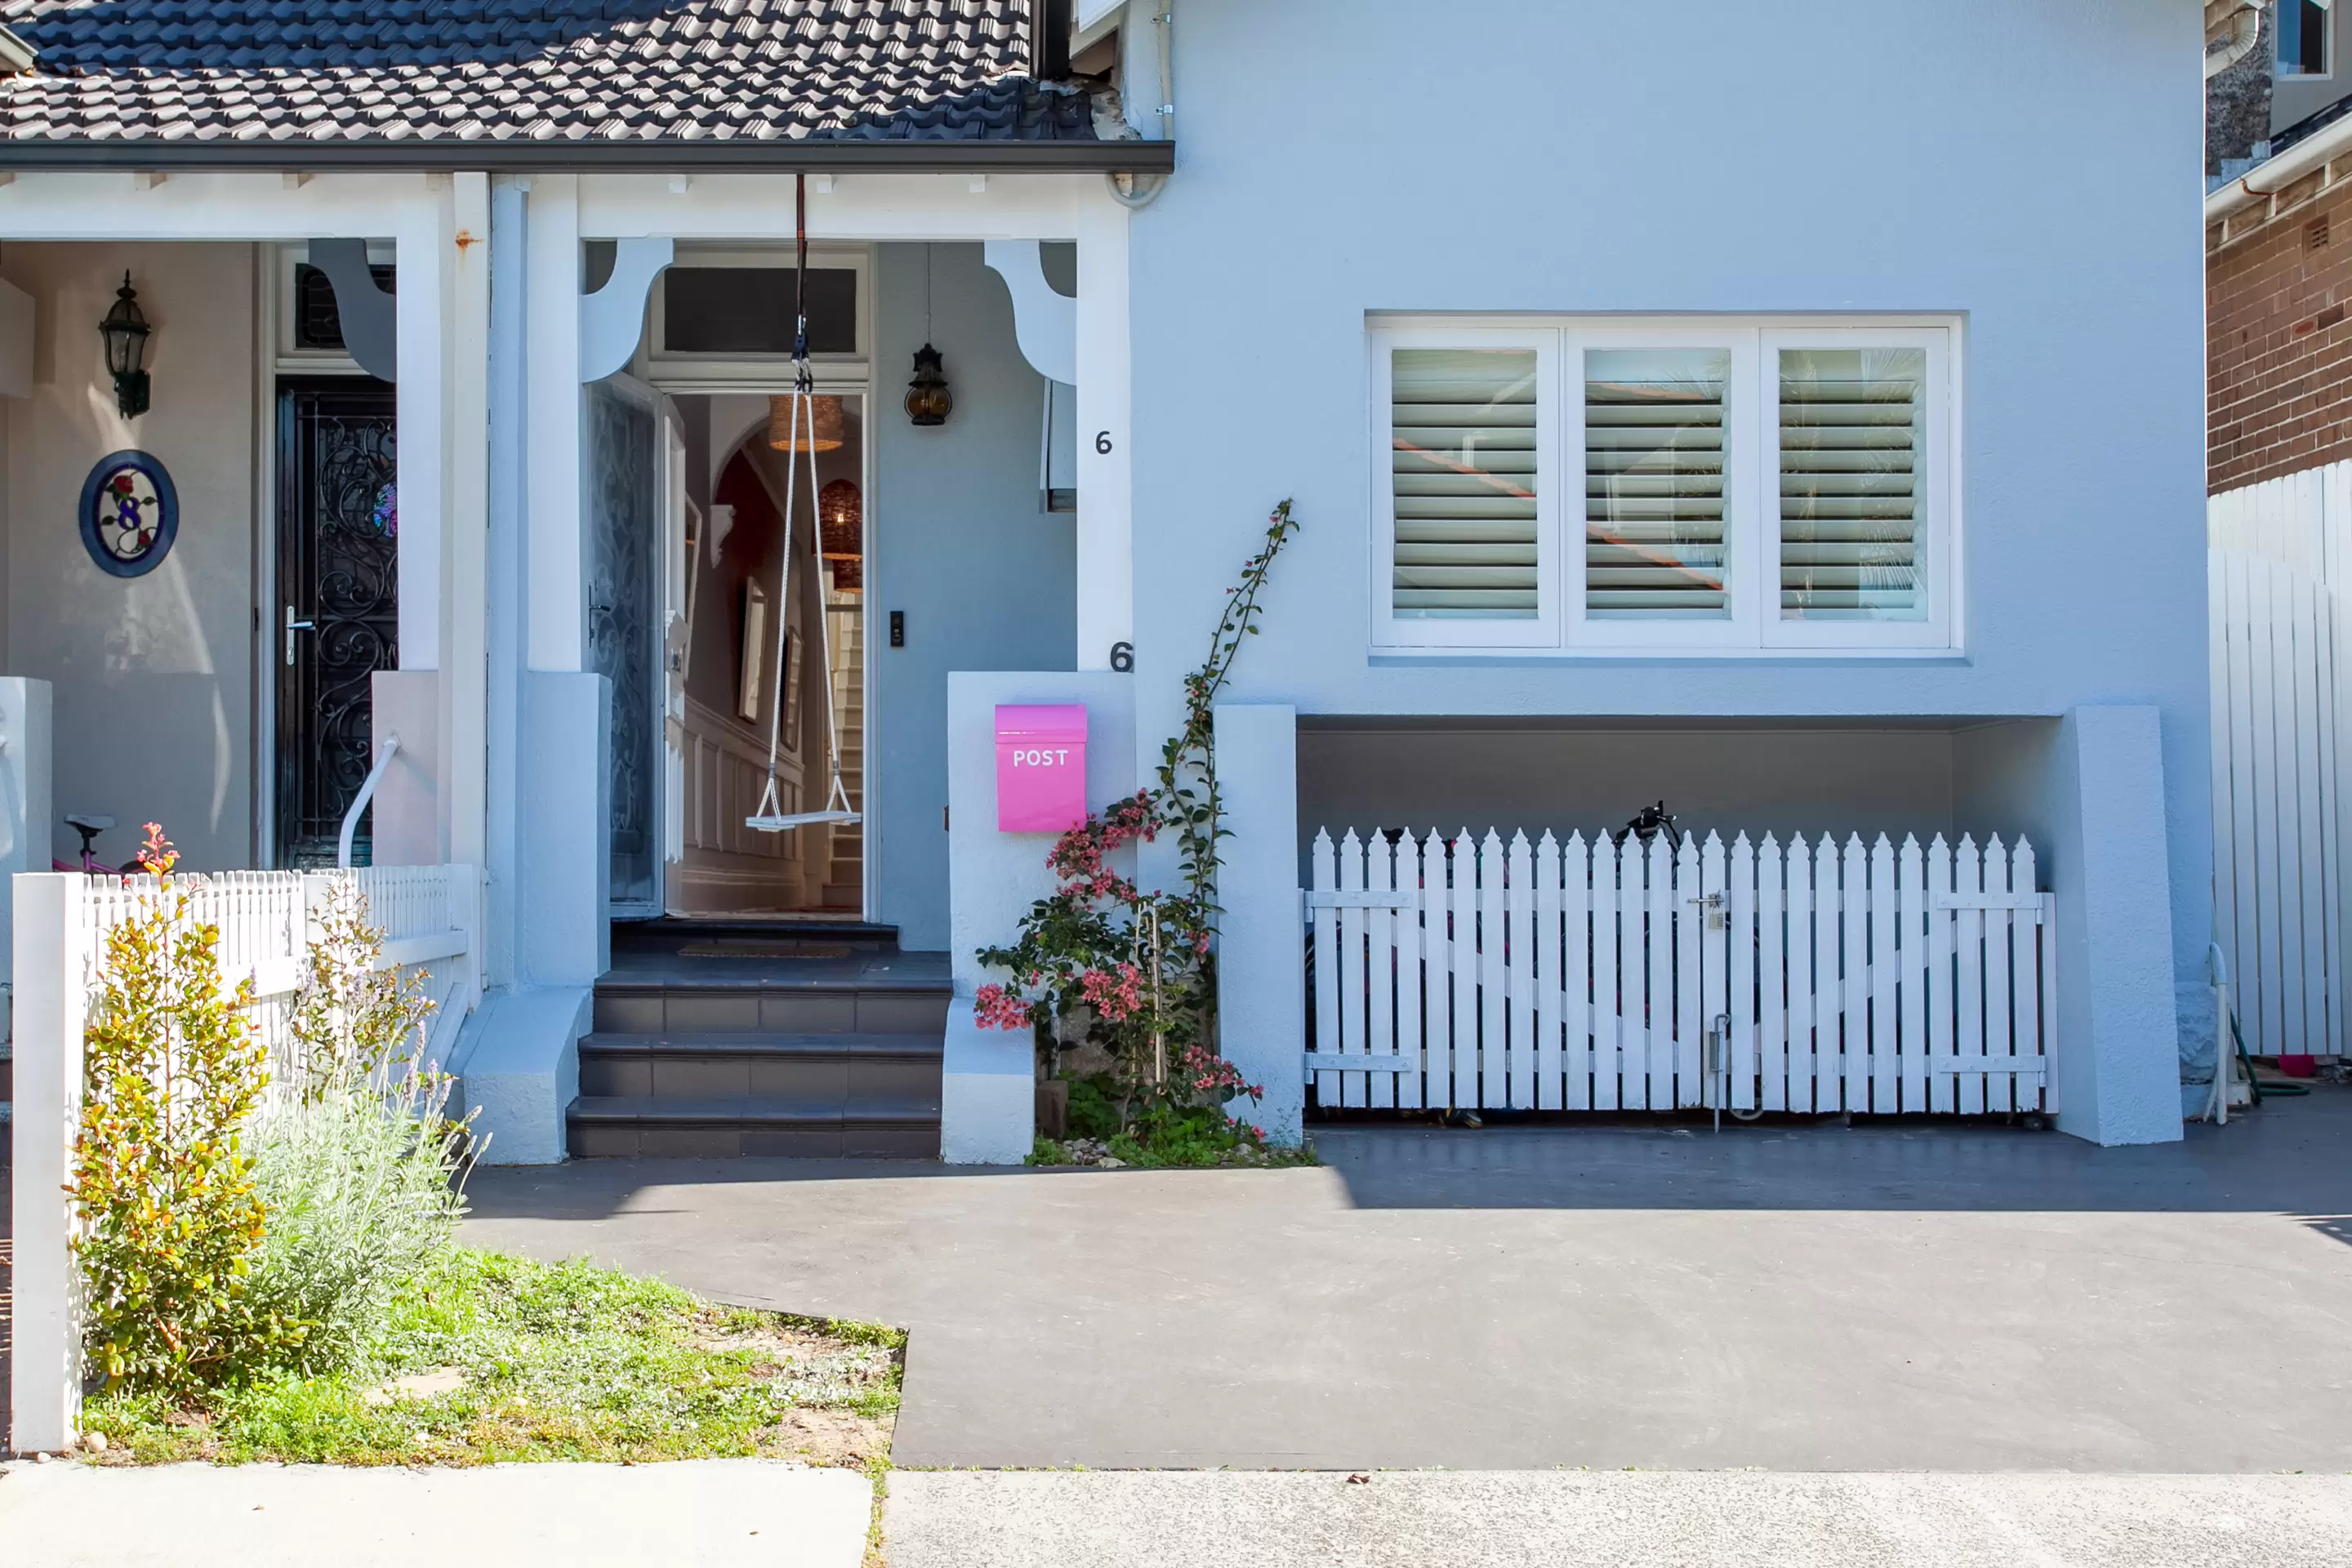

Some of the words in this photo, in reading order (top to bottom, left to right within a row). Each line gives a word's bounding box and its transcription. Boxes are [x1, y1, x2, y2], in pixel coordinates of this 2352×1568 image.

[1096, 431, 1112, 454] 6
[118, 497, 141, 529] 8
[1111, 642, 1134, 672] 6
[1013, 750, 1068, 766] POST
